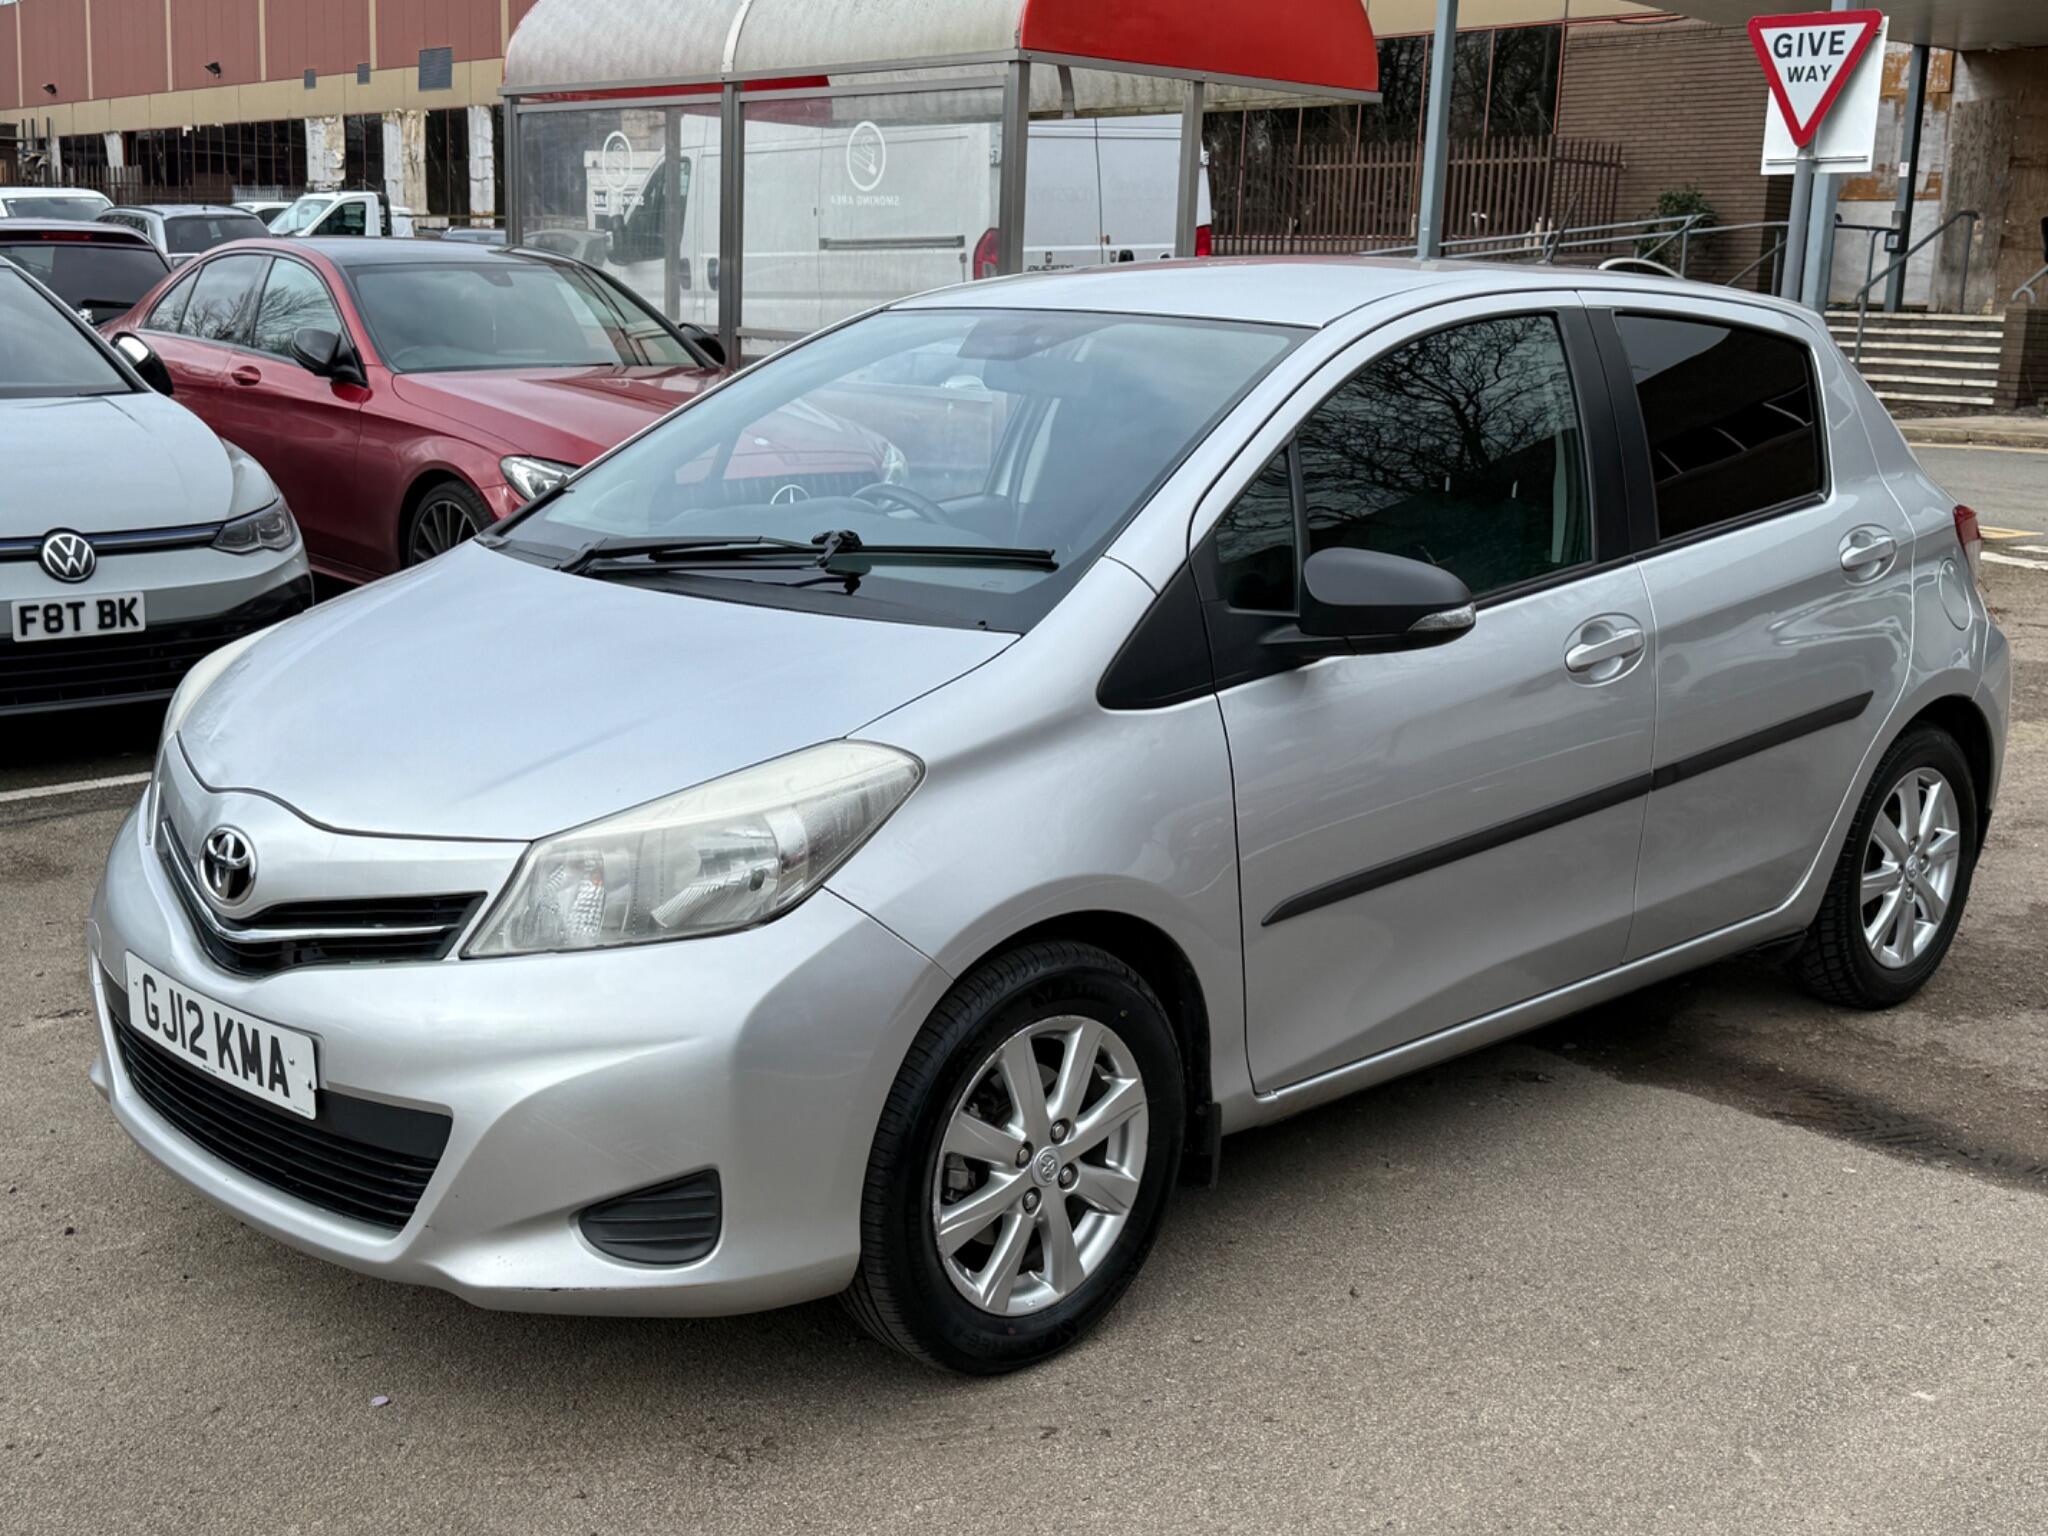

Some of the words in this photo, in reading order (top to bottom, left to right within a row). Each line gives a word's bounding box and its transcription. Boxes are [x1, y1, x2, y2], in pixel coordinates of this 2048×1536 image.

[1773, 30, 1846, 59] GIVE
[1787, 64, 1832, 83] WAY
[18, 601, 86, 636] F8T
[96, 597, 139, 630] BK
[142, 973, 208, 1062] GJ12
[213, 1011, 291, 1099] KMA
